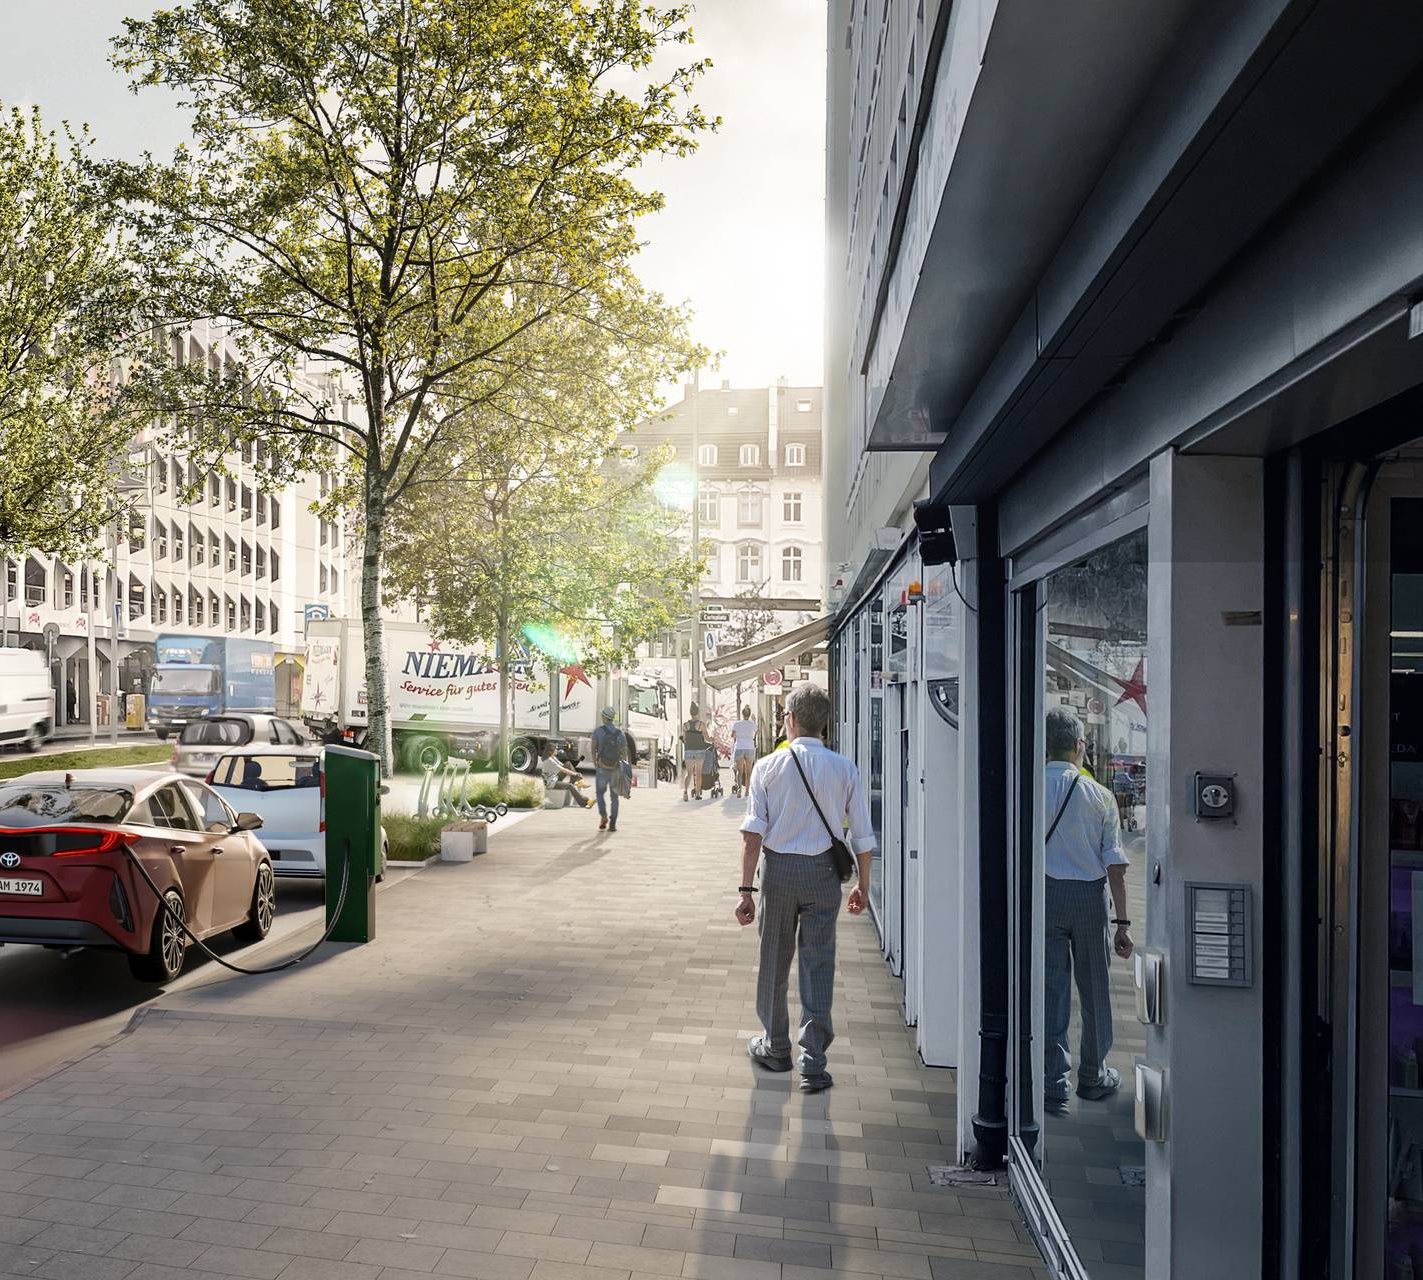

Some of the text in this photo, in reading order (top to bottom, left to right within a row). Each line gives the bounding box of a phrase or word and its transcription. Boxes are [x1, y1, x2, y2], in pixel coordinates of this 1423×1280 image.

[400, 680, 444, 697] Service
[443, 684, 464, 703] für
[466, 681, 497, 701] gutes
[14, 881, 40, 893] 1974
